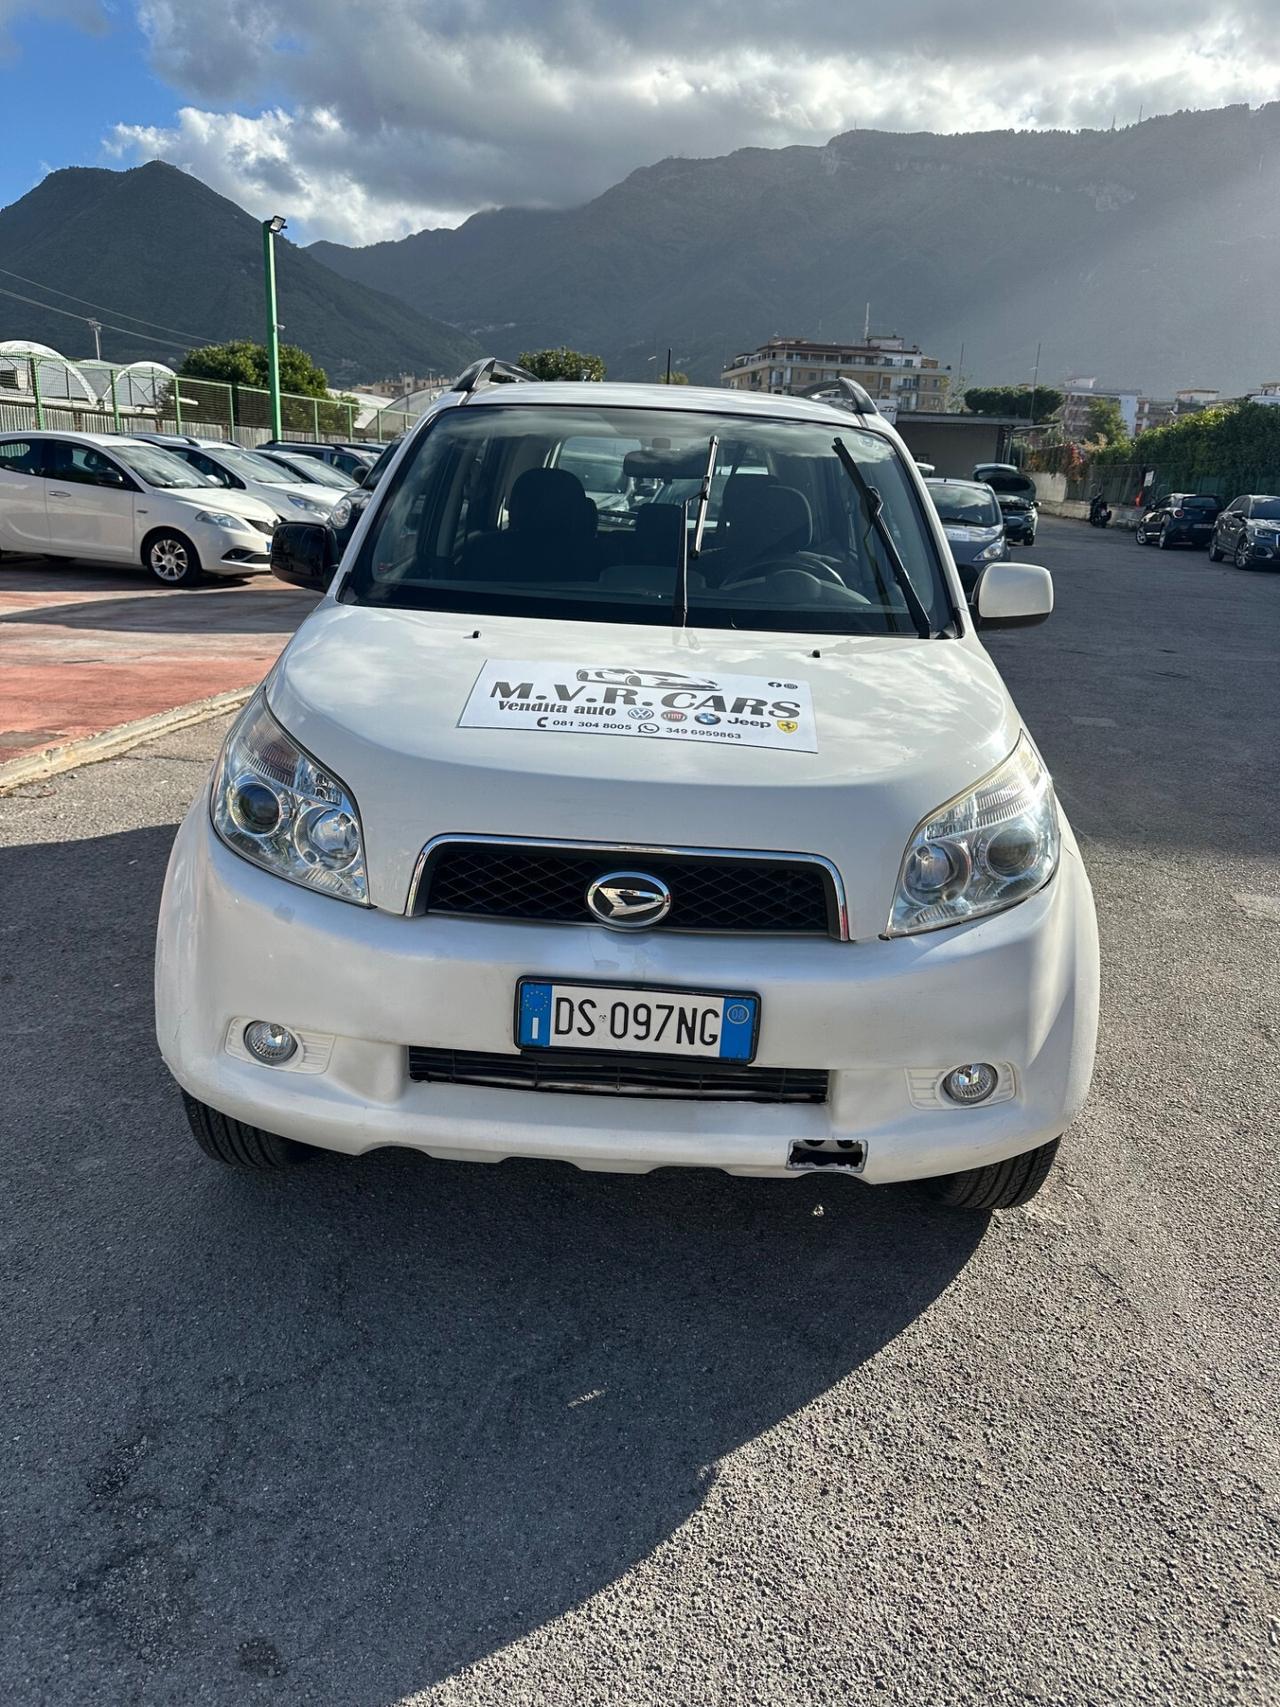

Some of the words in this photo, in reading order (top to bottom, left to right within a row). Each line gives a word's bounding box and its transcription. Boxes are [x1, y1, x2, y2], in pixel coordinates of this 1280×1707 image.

[498, 700, 567, 713] Vendita
[574, 704, 616, 716] auto
[578, 720, 599, 728] 304
[603, 722, 632, 730] 8005
[727, 717, 772, 728] Jeep
[666, 727, 687, 735] 349
[691, 729, 742, 739] 6959863
